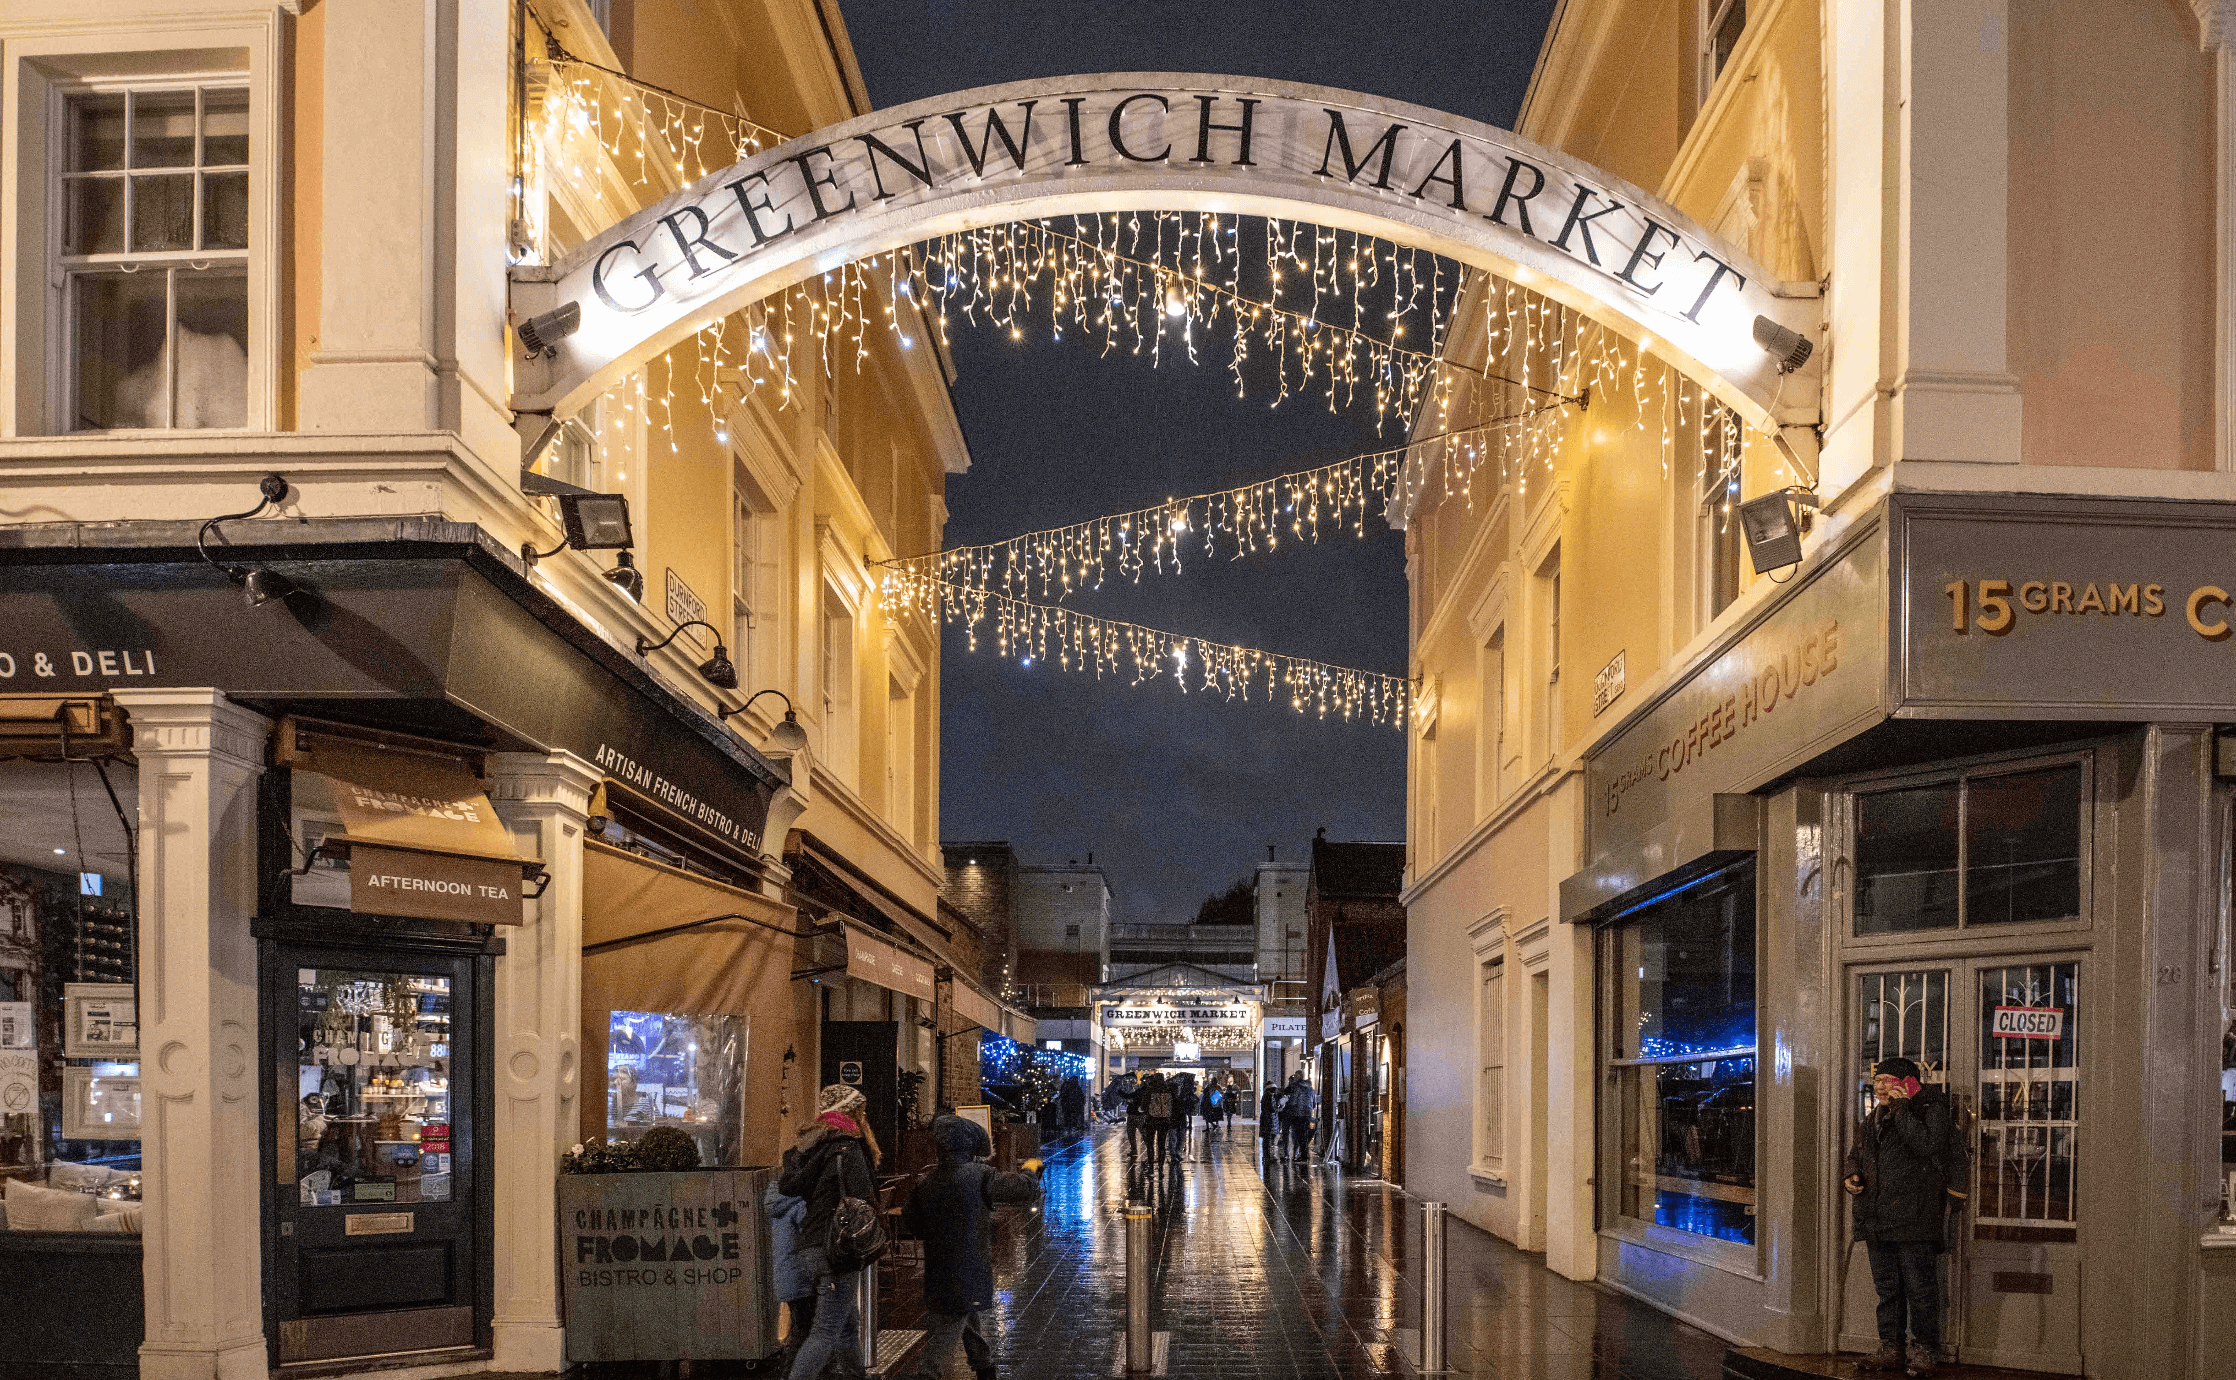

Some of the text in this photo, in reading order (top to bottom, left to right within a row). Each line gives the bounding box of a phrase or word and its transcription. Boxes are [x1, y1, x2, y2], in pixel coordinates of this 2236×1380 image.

[592, 94, 1747, 326] GREENWICH MARKET
[1946, 579, 2014, 635] 15
[2020, 580, 2165, 616] GRAMS
[34, 652, 56, 677] &
[71, 650, 156, 676] DELI
[1606, 774, 1620, 817] 15
[1658, 693, 1736, 782] COFFEE
[1740, 618, 1838, 728] HOUSE
[355, 796, 481, 823] FROMAGE
[595, 743, 762, 851] ARTISAN FRENCH BISTRO & DELI
[367, 874, 509, 900] AFTERNOON TEA
[1106, 1010, 1248, 1019] GREENWICH MARKET
[1999, 1012, 2057, 1033] CLOSED
[575, 1207, 708, 1230] CHAMPAGNE
[576, 1232, 740, 1264] FROMAGE
[578, 1267, 742, 1287] BISTRO & SHOP
